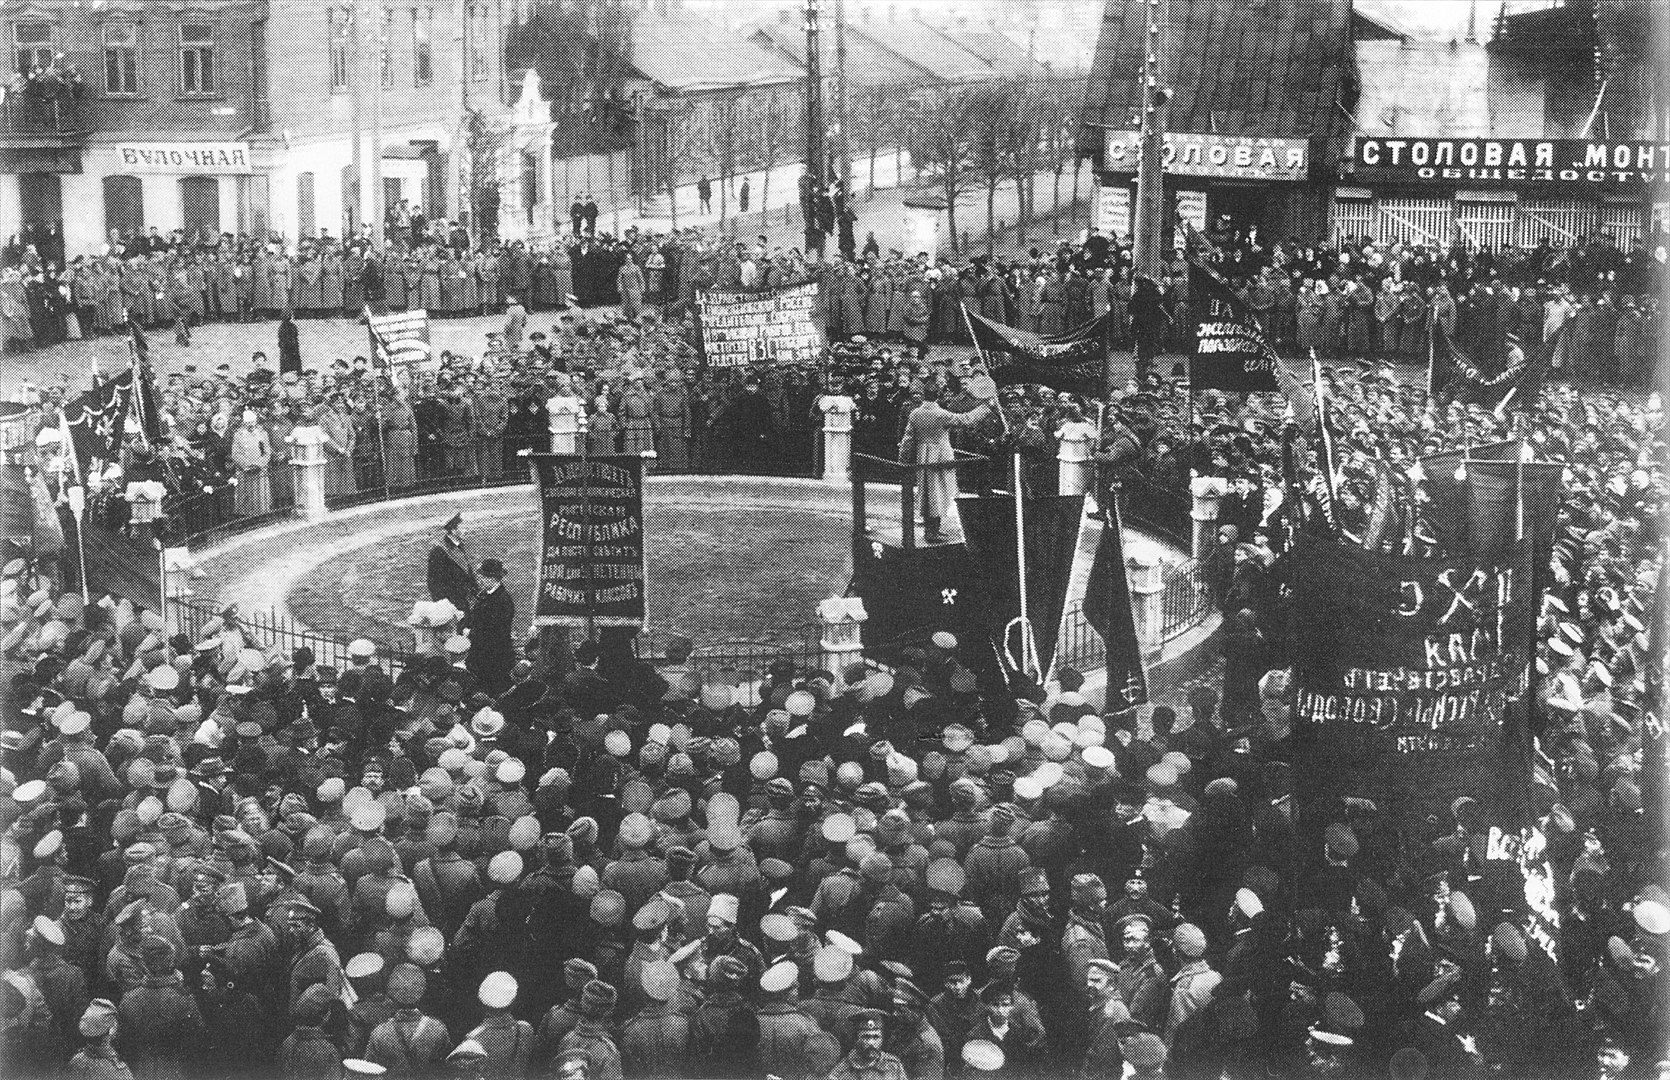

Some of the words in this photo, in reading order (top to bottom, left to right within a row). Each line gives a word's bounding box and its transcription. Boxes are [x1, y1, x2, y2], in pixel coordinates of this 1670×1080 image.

[122, 147, 246, 166] БУЛОЧНАЯ
[1109, 140, 1304, 169] СОЛОВАЯ
[1363, 141, 1553, 167] СТОЛОВАЯ
[1418, 168, 1670, 182] ОБЩЕДОСТУ
